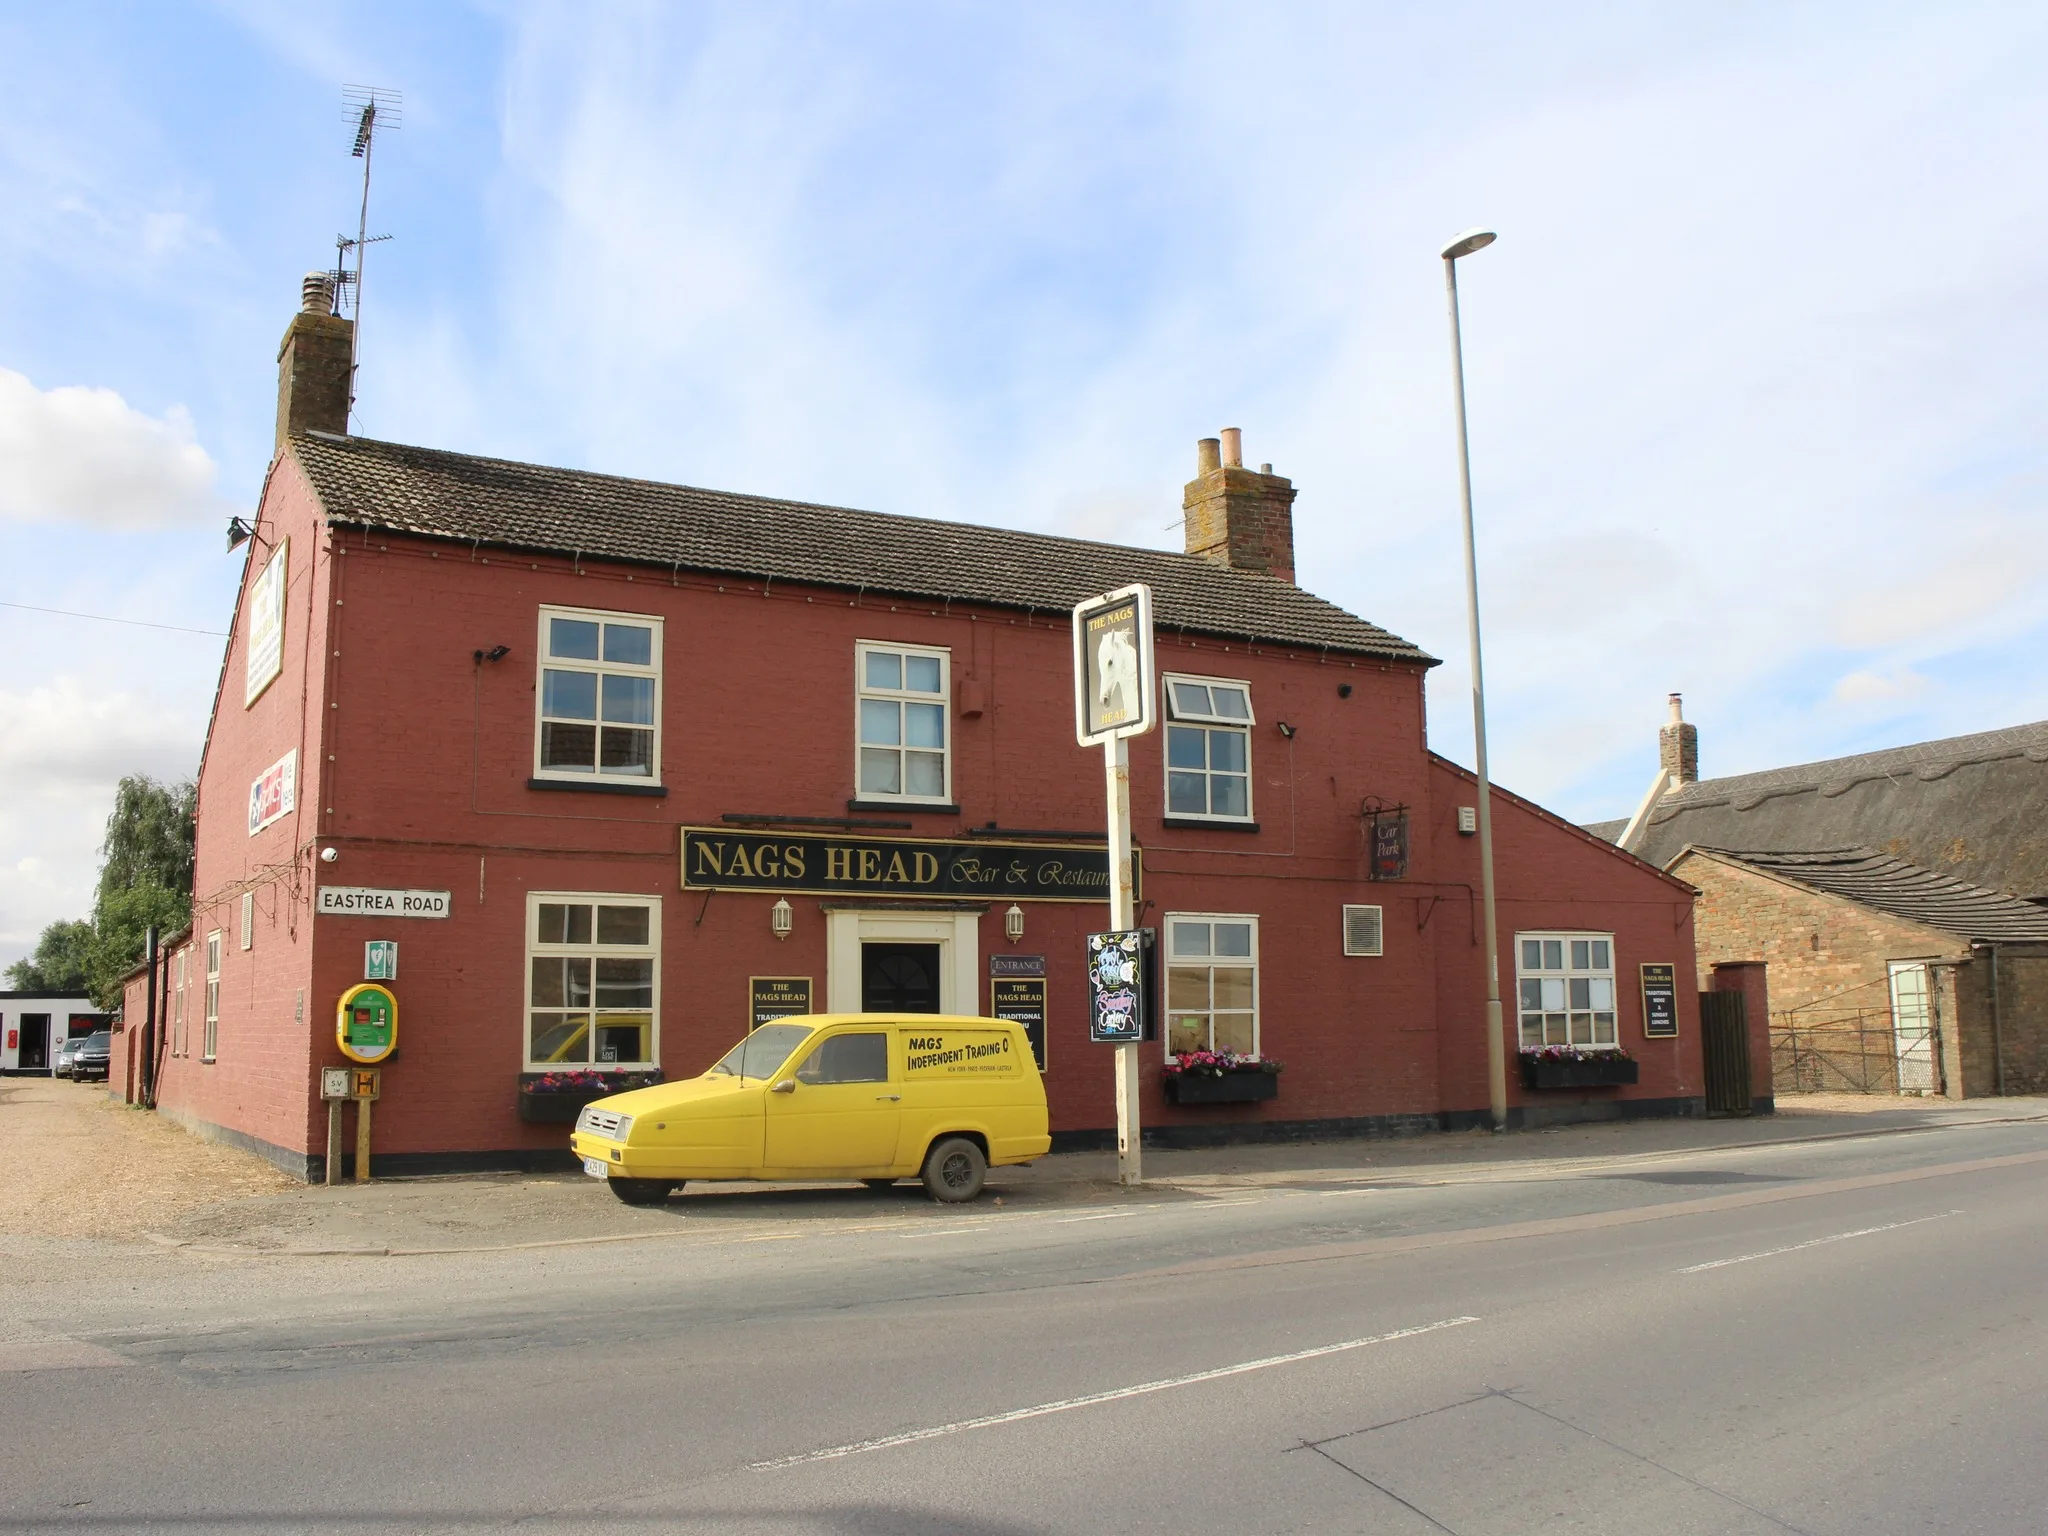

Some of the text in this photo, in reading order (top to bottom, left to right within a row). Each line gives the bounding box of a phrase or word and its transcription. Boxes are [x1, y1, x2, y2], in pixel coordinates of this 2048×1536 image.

[1089, 608, 1133, 631] THE NAGS
[1101, 708, 1127, 724] HEAD
[1378, 826, 1398, 839] Car
[1378, 840, 1400, 856] Park
[694, 841, 805, 879] NAGS
[824, 847, 939, 884] HEAD
[951, 858, 999, 883] Bar
[1005, 860, 1030, 884] &
[324, 893, 444, 912] EASTREA ROAD
[995, 961, 1041, 970] ENTRANCE
[755, 993, 806, 1001] NAGS HEAD
[908, 1037, 943, 1051] NAGS
[907, 1049, 964, 1071] INDEPENDENT
[965, 1042, 1000, 1060] TRADING
